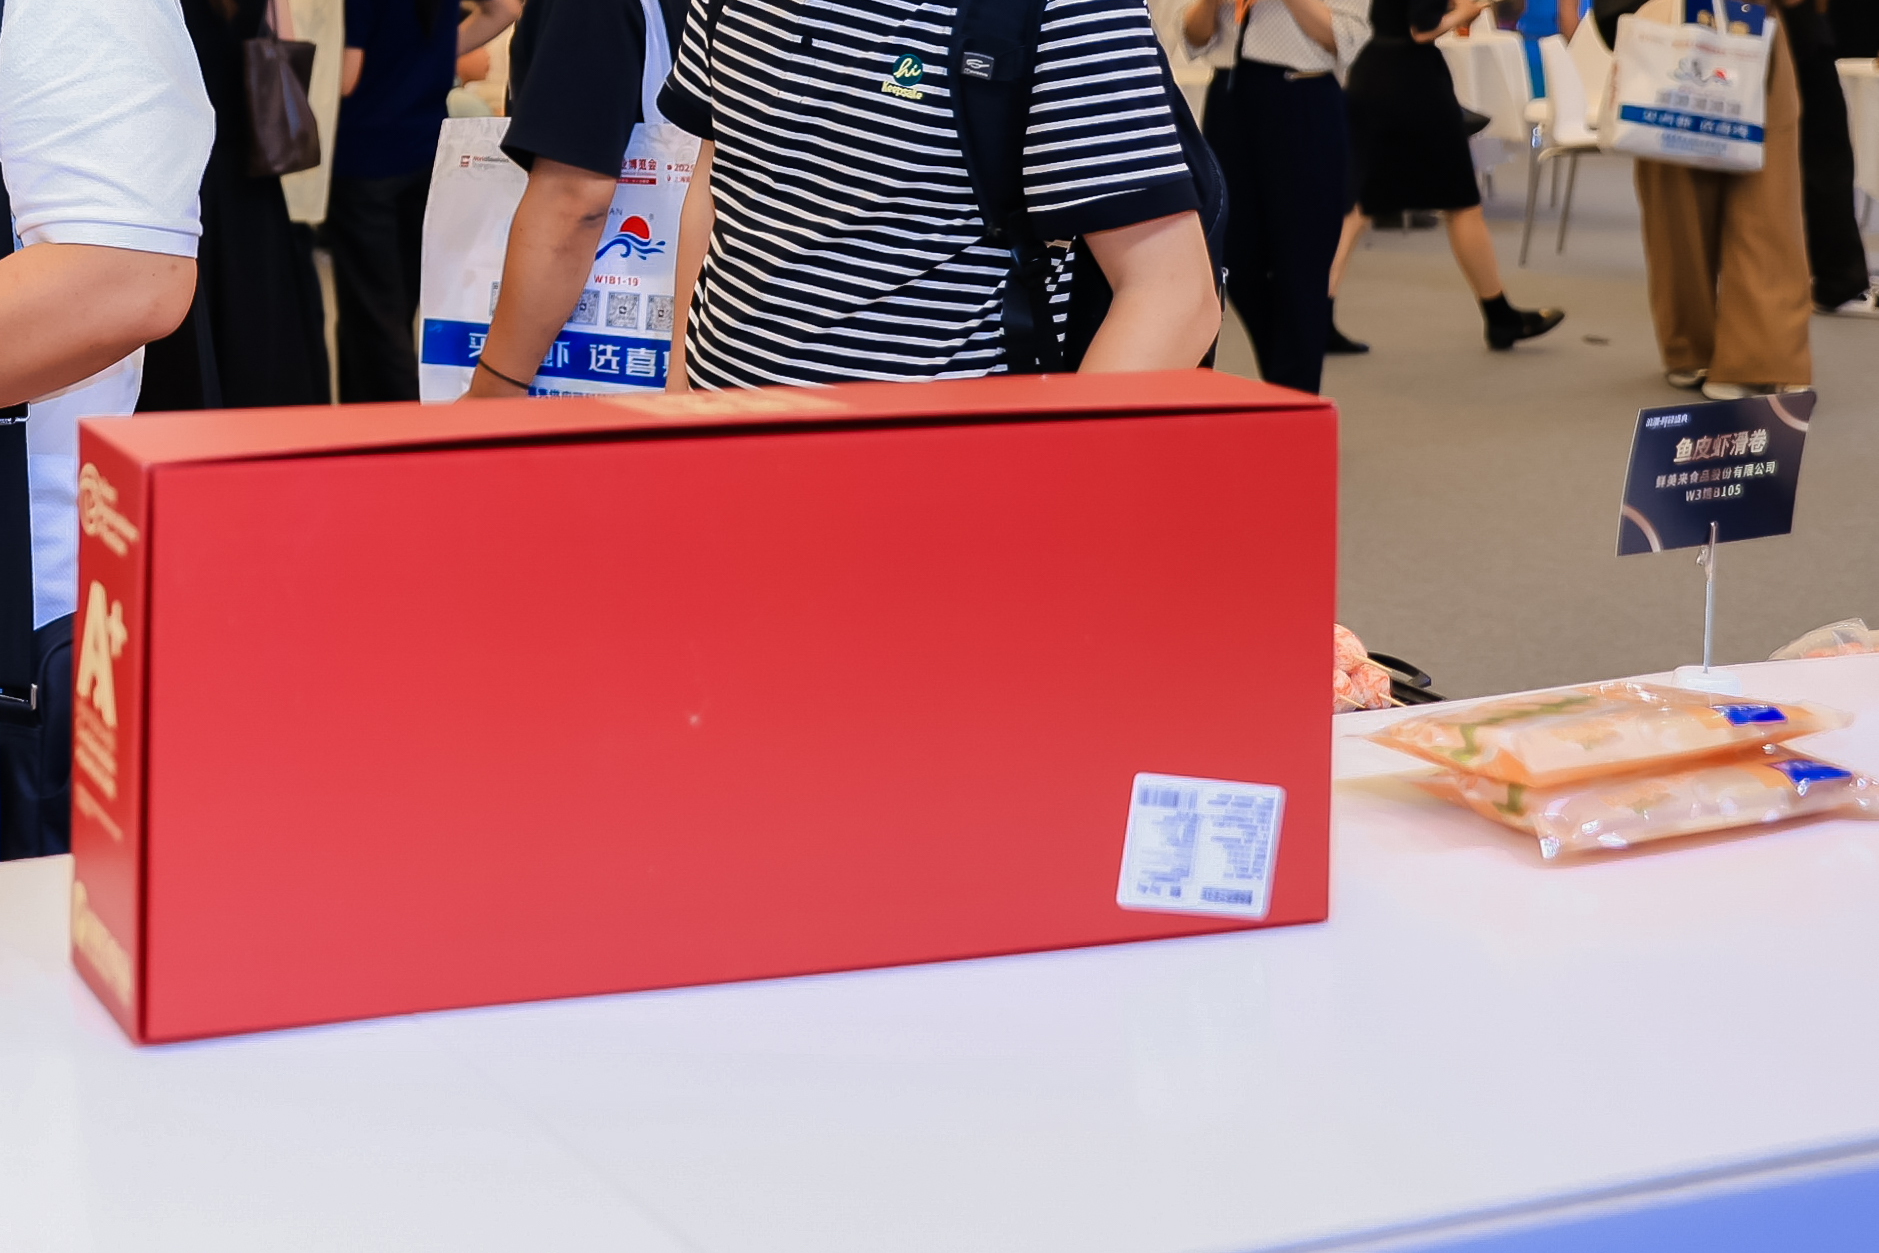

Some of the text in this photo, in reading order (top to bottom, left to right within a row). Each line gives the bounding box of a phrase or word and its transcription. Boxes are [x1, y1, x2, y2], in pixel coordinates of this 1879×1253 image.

[893, 58, 922, 78] hi
[594, 275, 639, 286] W1B1-19
[589, 343, 669, 379] 选喜
[1673, 429, 1767, 463] 鱼皮虾滑卷
[1655, 461, 1776, 488] 鲜美来食品股份有限公司
